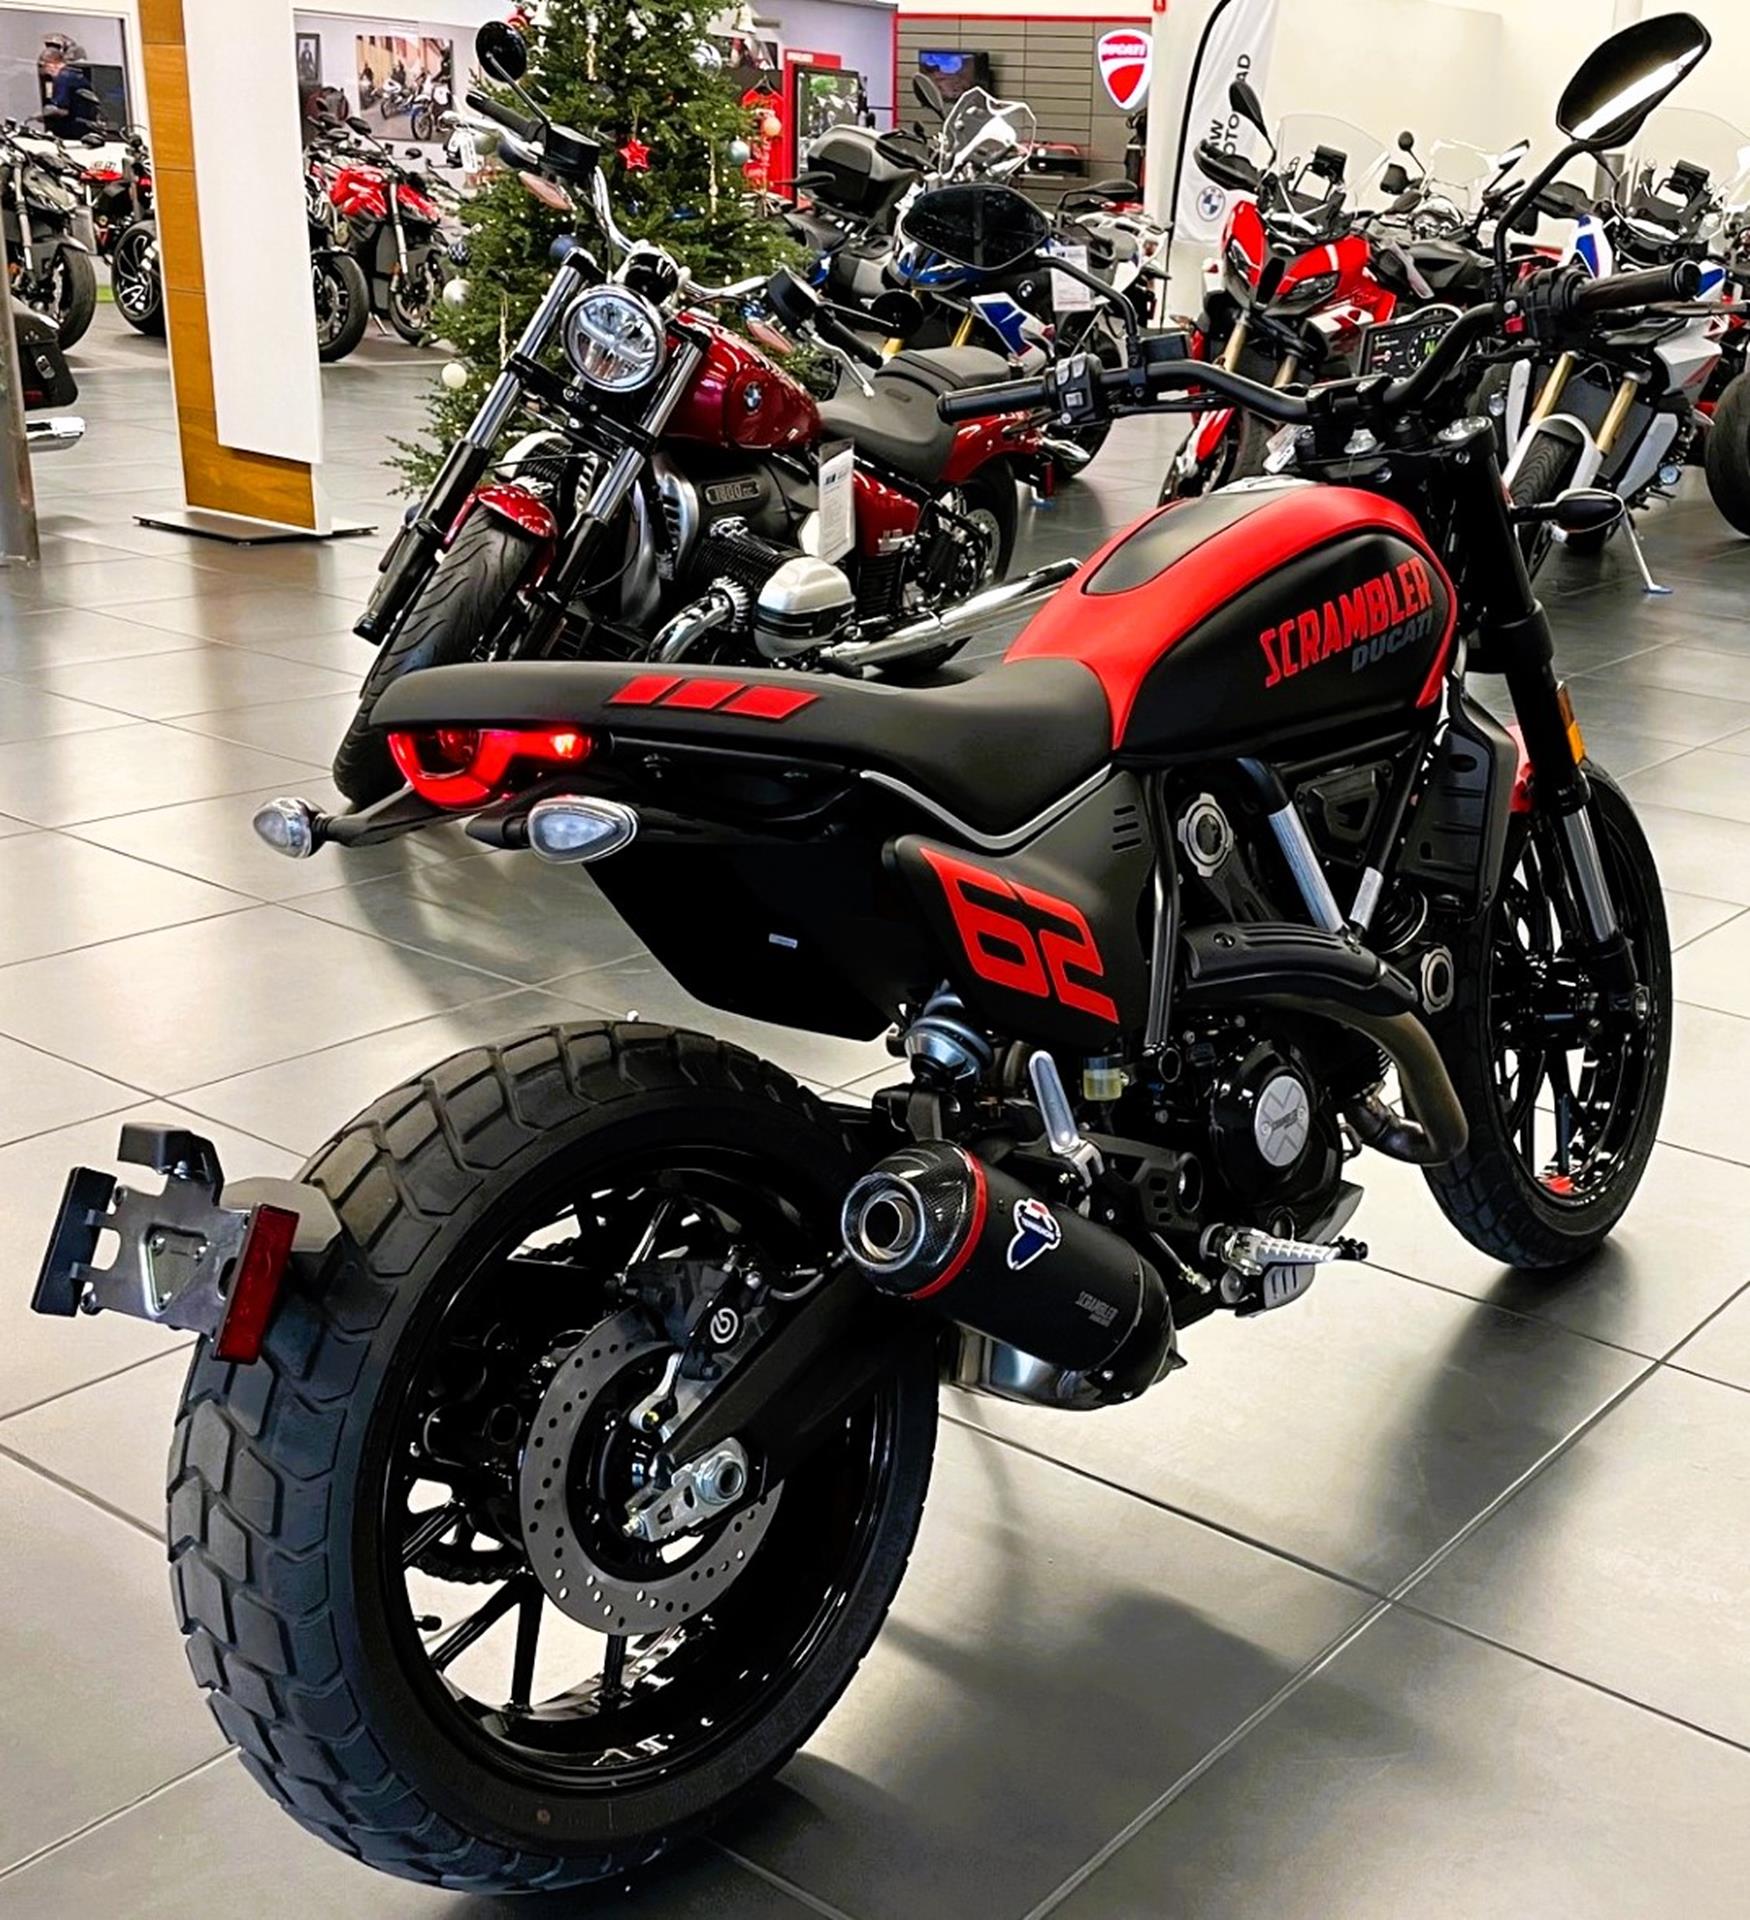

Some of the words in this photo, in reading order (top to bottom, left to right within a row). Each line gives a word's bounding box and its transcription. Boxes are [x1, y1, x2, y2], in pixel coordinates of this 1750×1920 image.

[1222, 53, 1251, 156] OTOAD
[1259, 556, 1432, 688] SCRAMBLER
[1351, 607, 1433, 674] DUCATI
[919, 847, 1120, 1025] 62
